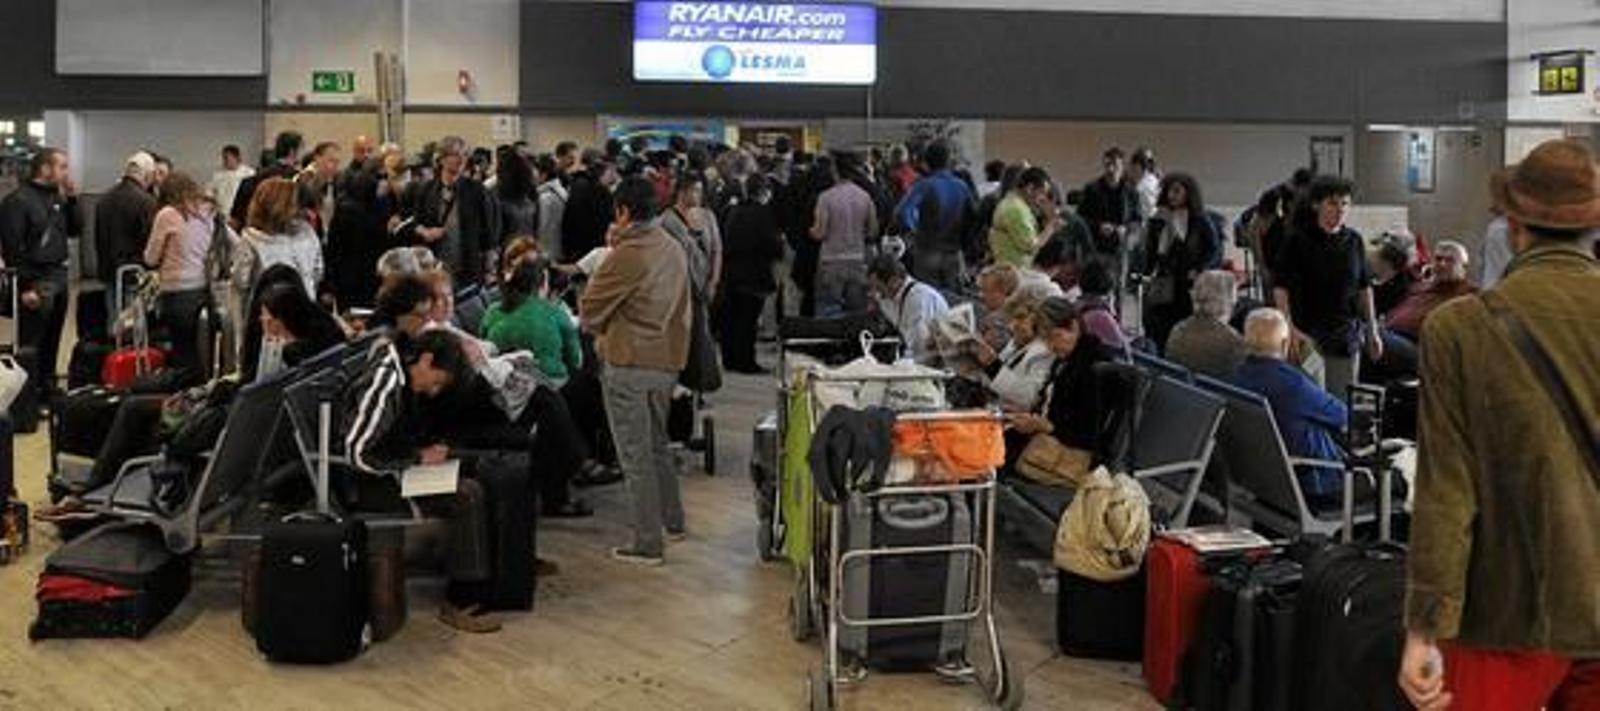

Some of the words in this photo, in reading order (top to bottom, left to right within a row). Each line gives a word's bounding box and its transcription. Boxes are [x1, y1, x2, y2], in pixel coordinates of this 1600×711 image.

[669, 3, 846, 25] RYANAIR.com
[667, 25, 711, 38] FLY
[718, 26, 846, 40] CHEAPER
